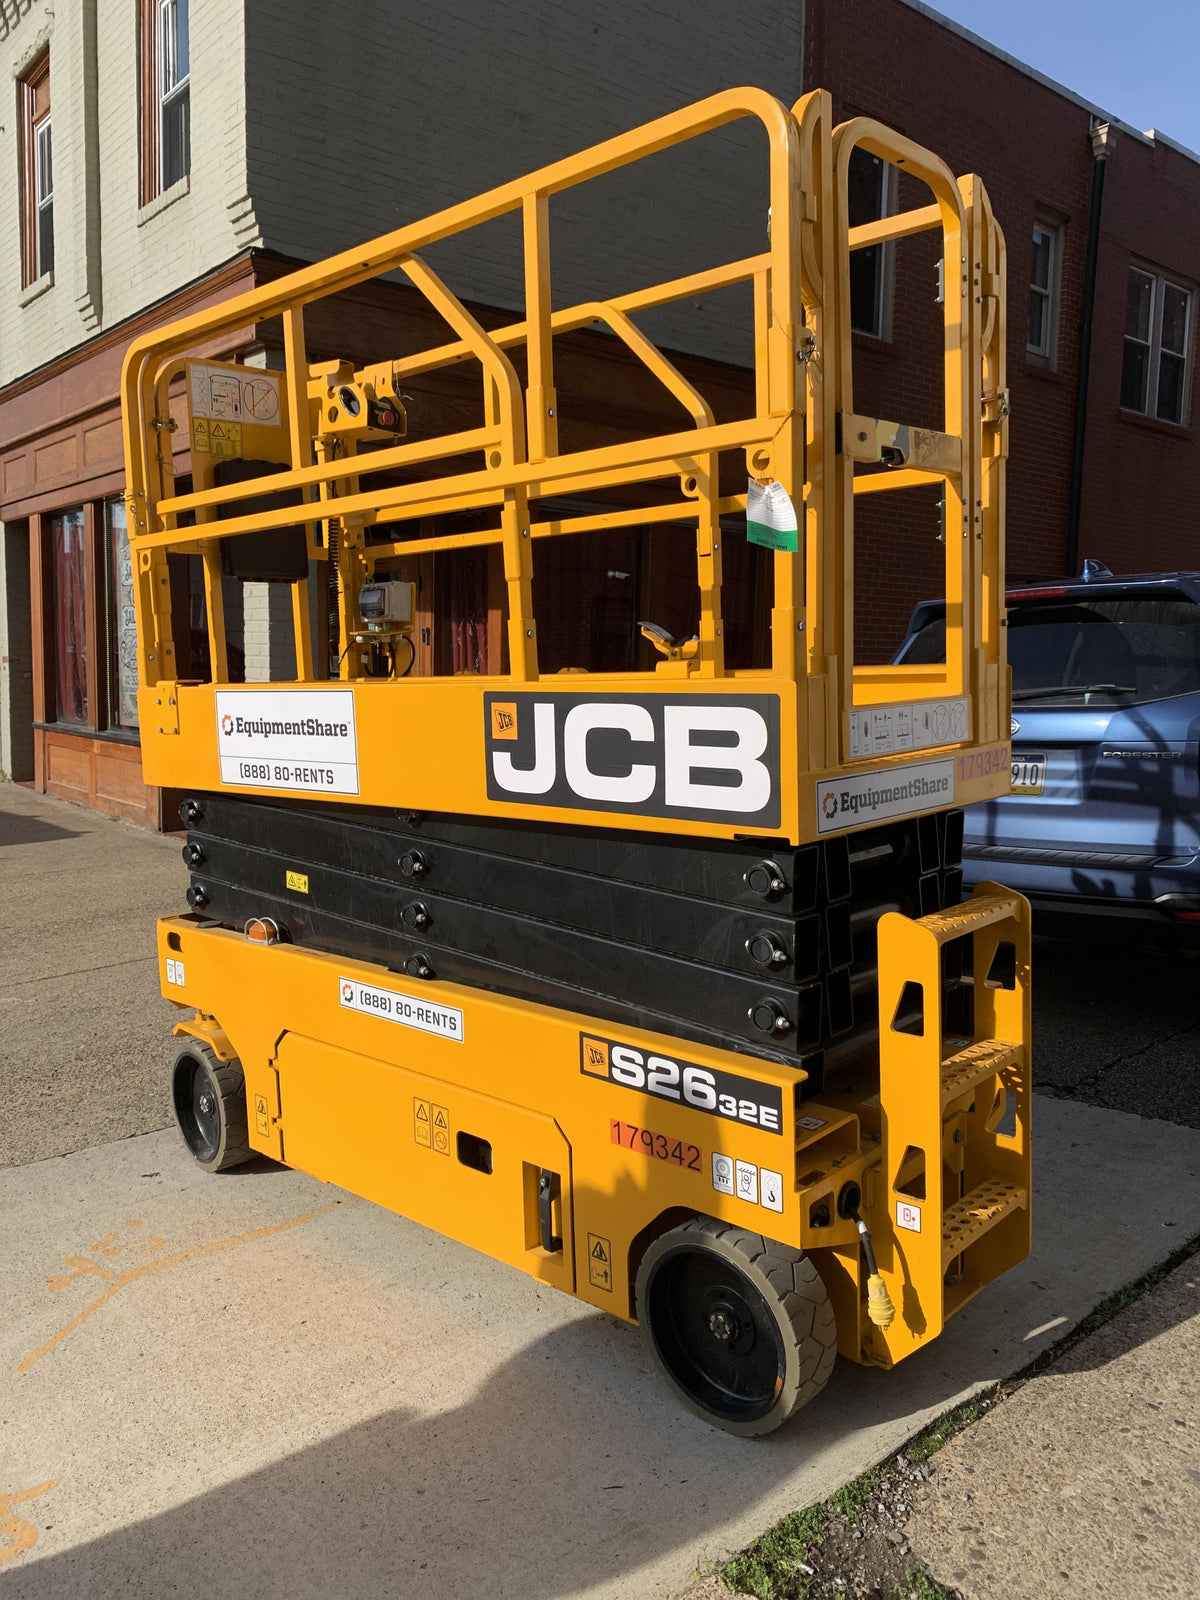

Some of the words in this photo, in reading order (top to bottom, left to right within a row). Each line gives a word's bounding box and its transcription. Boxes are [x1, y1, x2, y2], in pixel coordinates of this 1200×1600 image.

[235, 716, 348, 739] EquipmentShare
[498, 712, 513, 730] JCB
[492, 702, 771, 813] JCB
[959, 748, 1009, 782] 179342
[1102, 751, 1182, 760] FORESTER
[239, 762, 271, 781] (888)
[274, 766, 334, 785] 80-RENTS
[1010, 763, 1039, 786] 910
[840, 776, 949, 815] EquipmentShare
[360, 990, 392, 1013] (888)
[396, 1001, 457, 1031] 80-RENTS
[589, 1047, 605, 1065] JCB
[612, 1120, 701, 1172] 179342
